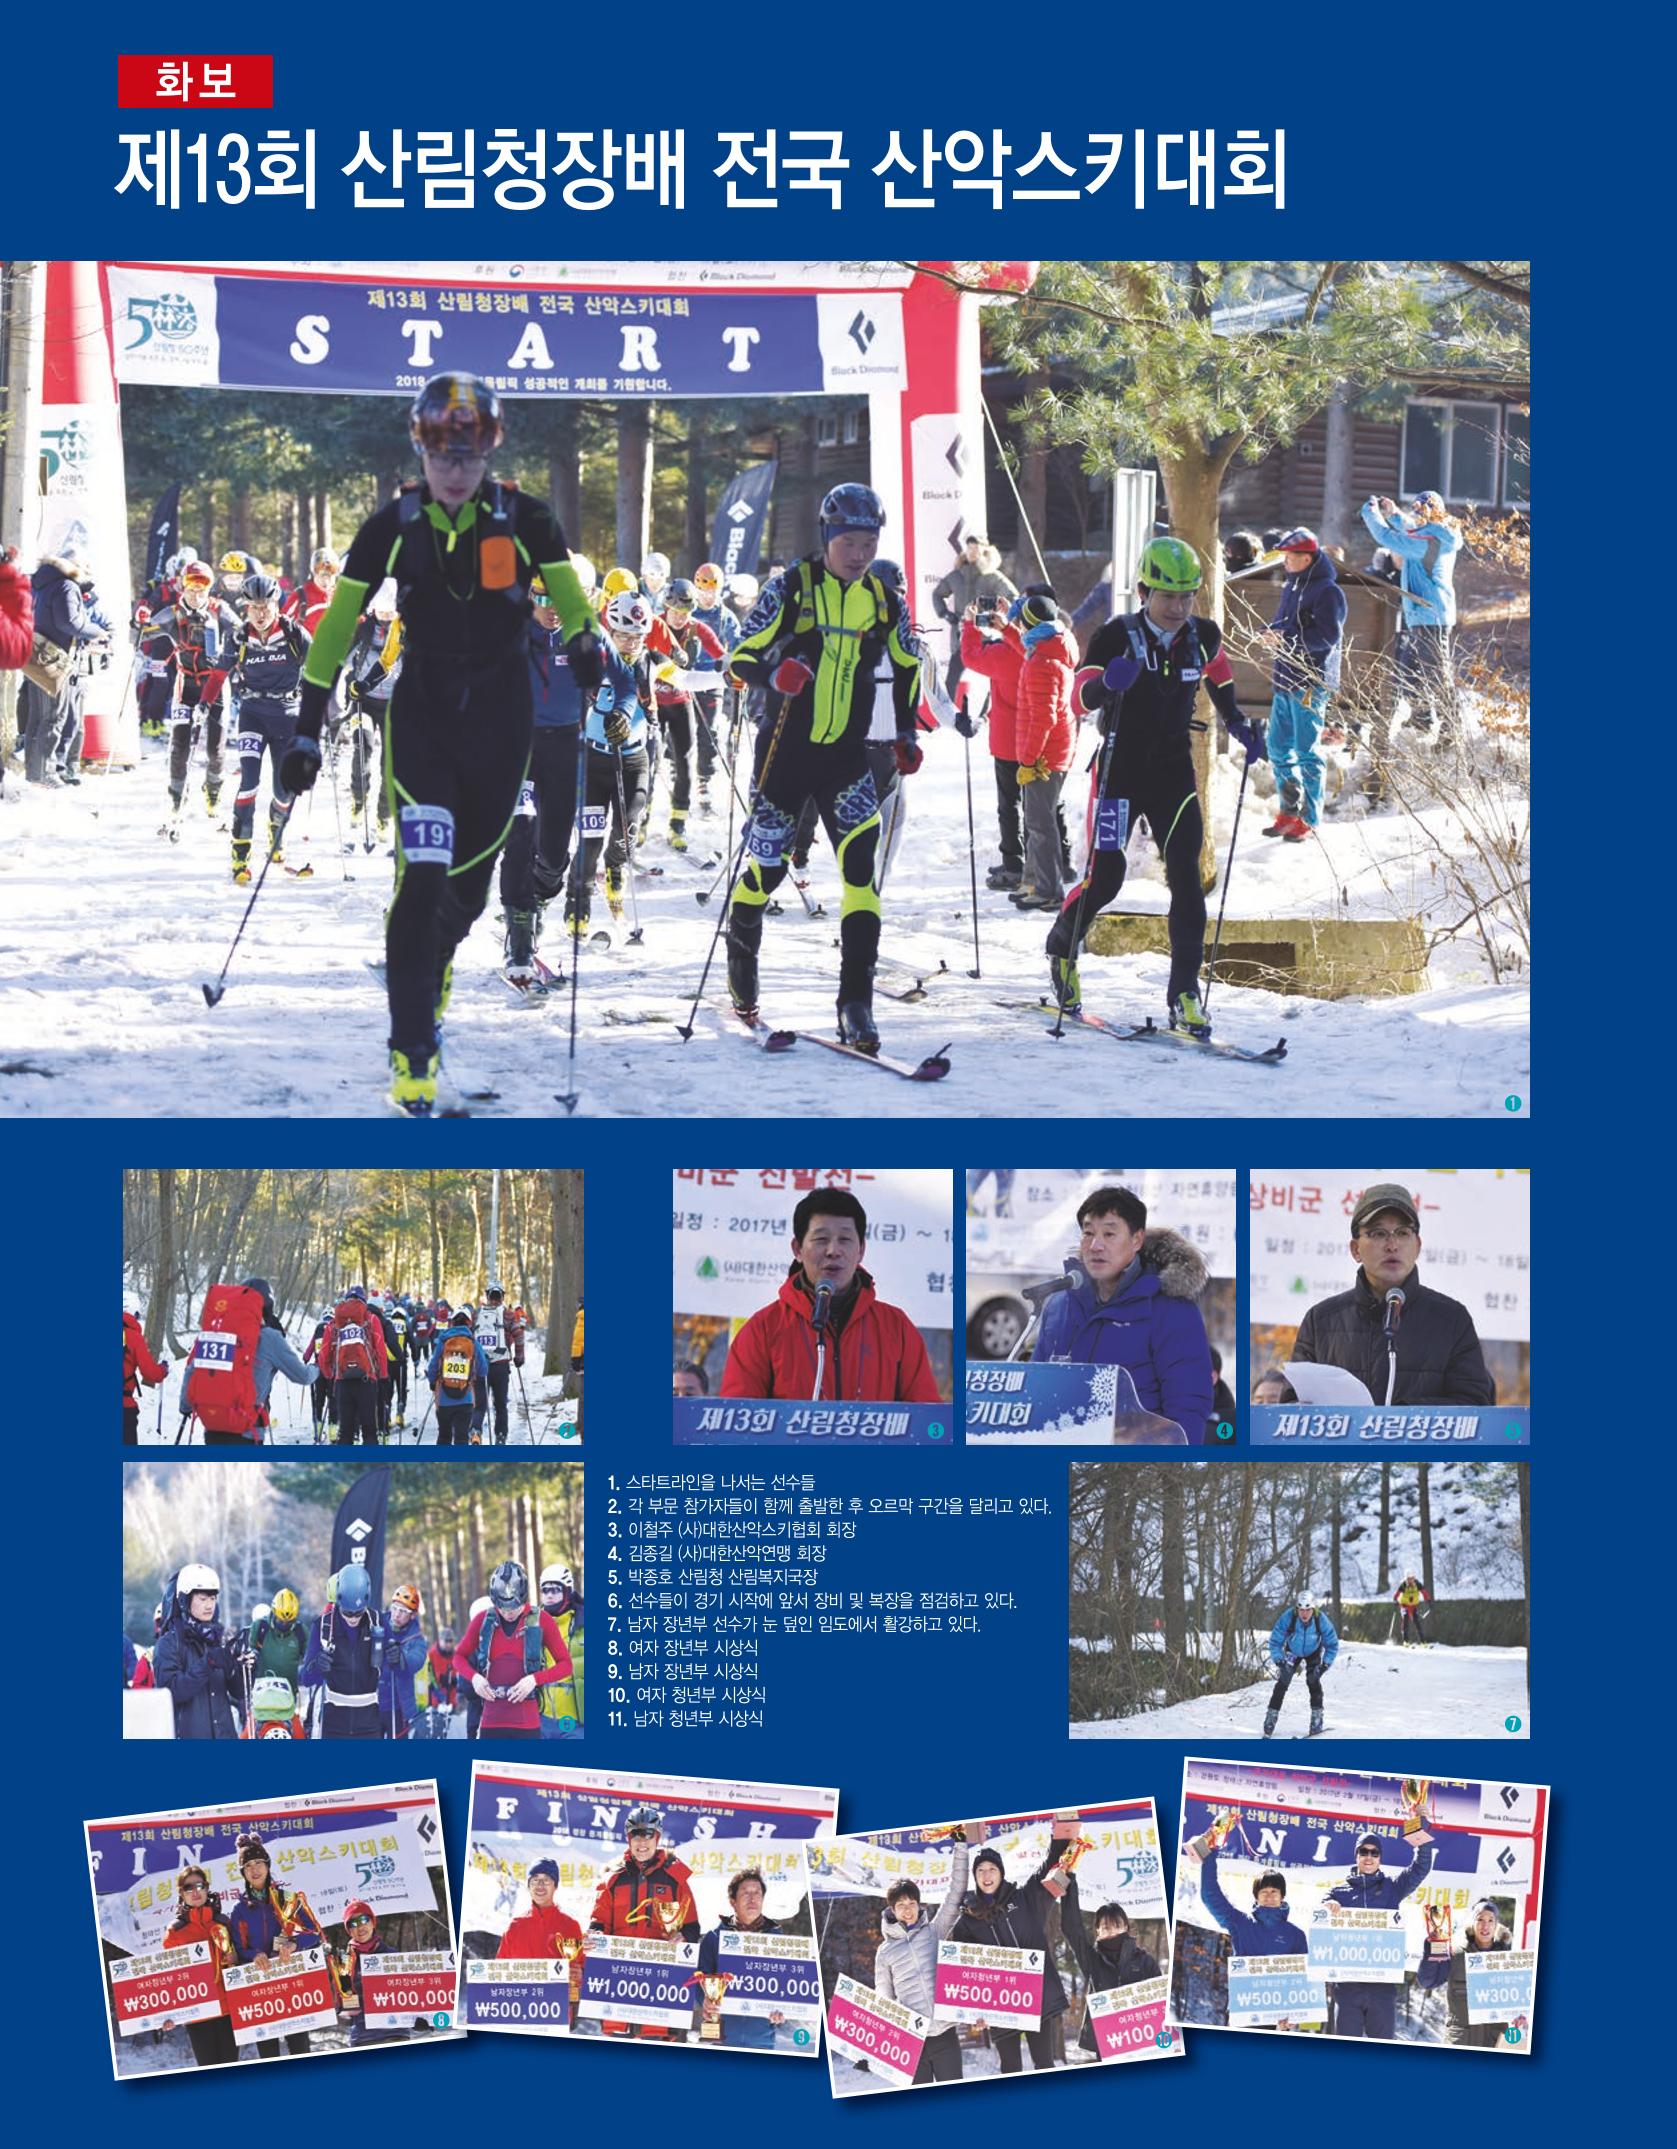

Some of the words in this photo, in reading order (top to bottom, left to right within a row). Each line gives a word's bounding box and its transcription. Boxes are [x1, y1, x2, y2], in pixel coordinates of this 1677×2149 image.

[367, 289, 427, 311] 제13회
[436, 291, 529, 314] 산림청장배
[539, 294, 574, 315] 전국
[584, 296, 690, 317] 산악스키대회
[831, 365, 858, 376] Black
[581, 815, 606, 829] 109
[1100, 807, 1117, 843] 171
[728, 1216, 788, 1237] 2017년
[201, 1342, 228, 1360] 131
[447, 1363, 466, 1374] 203
[696, 1407, 775, 1433] 제13회
[785, 1409, 910, 1437] 산림청장배
[1273, 1414, 1350, 1438] 제13회
[1358, 1415, 1479, 1440] 산림청장배
[1246, 1808, 1302, 1827] 산림청장배
[1306, 1816, 1329, 1830] 전국
[275, 1834, 400, 1873] 산악스키대회
[1312, 1945, 1401, 1964] ₩1,000,000
[124, 1981, 208, 2013] ₩300,000
[587, 1976, 690, 2004] ₩1,000,000
[944, 1983, 1033, 2008] ₩500,000
[1236, 1989, 1319, 2008] ₩500,000
[238, 1988, 324, 2022] ₩500,000
[475, 2001, 561, 2021] ₩500,000
[834, 2013, 911, 2066] ₩300,000
